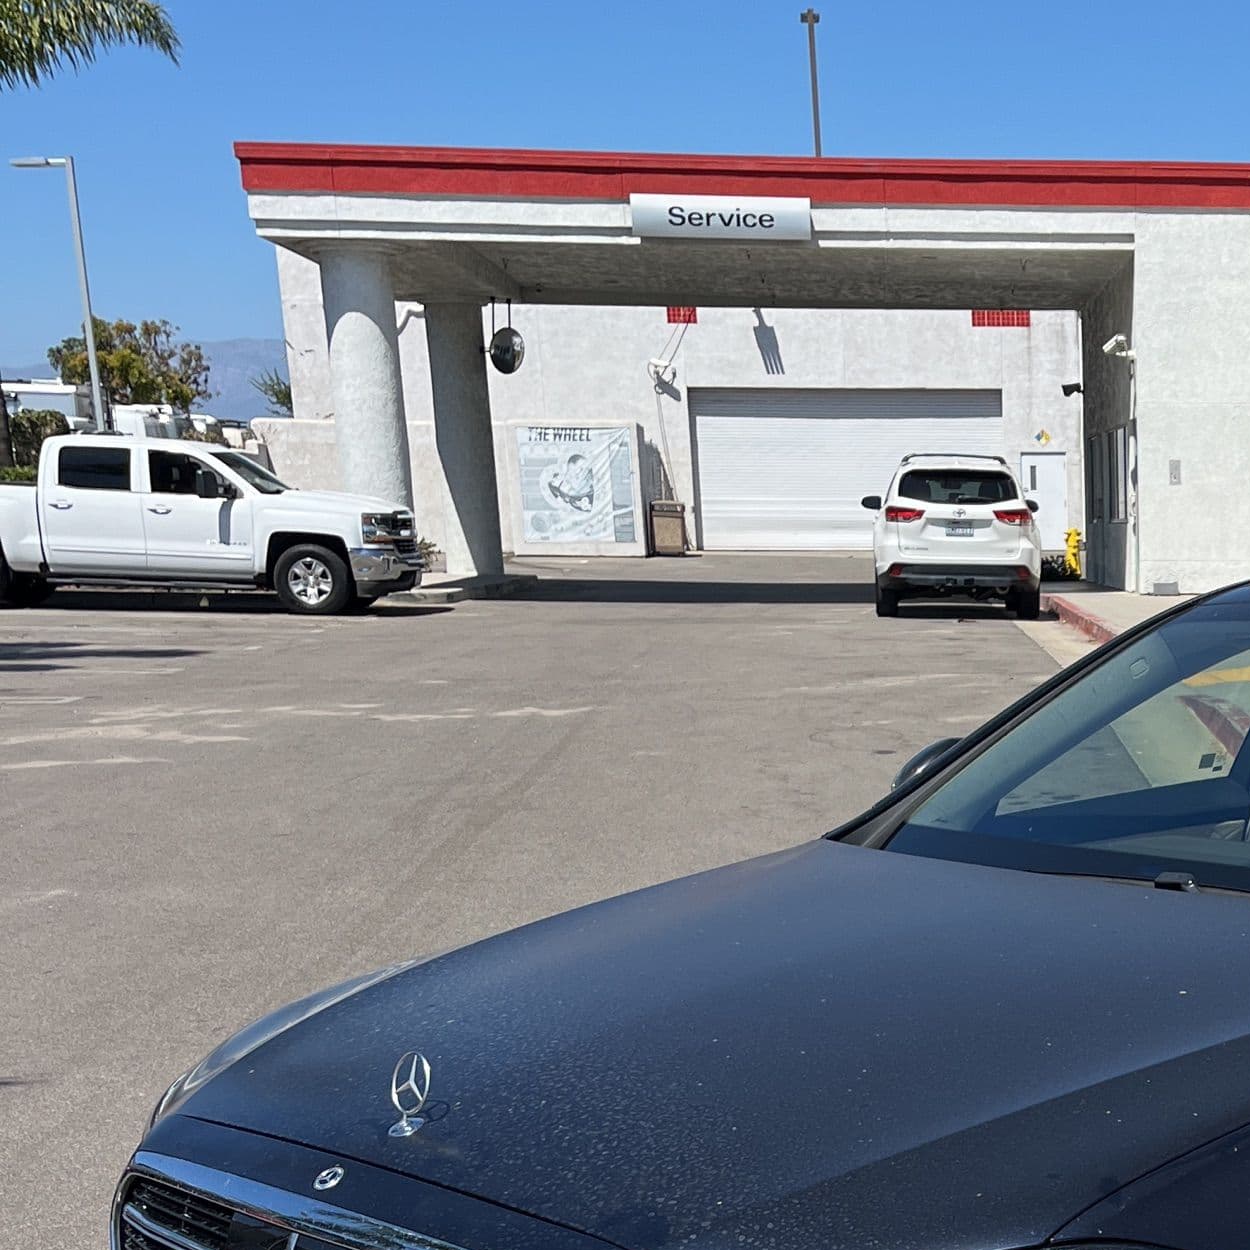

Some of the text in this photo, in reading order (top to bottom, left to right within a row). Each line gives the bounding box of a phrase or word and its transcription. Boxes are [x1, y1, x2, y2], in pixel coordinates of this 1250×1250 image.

[667, 205, 776, 229] Service
[528, 426, 592, 442] THE WHEEL
